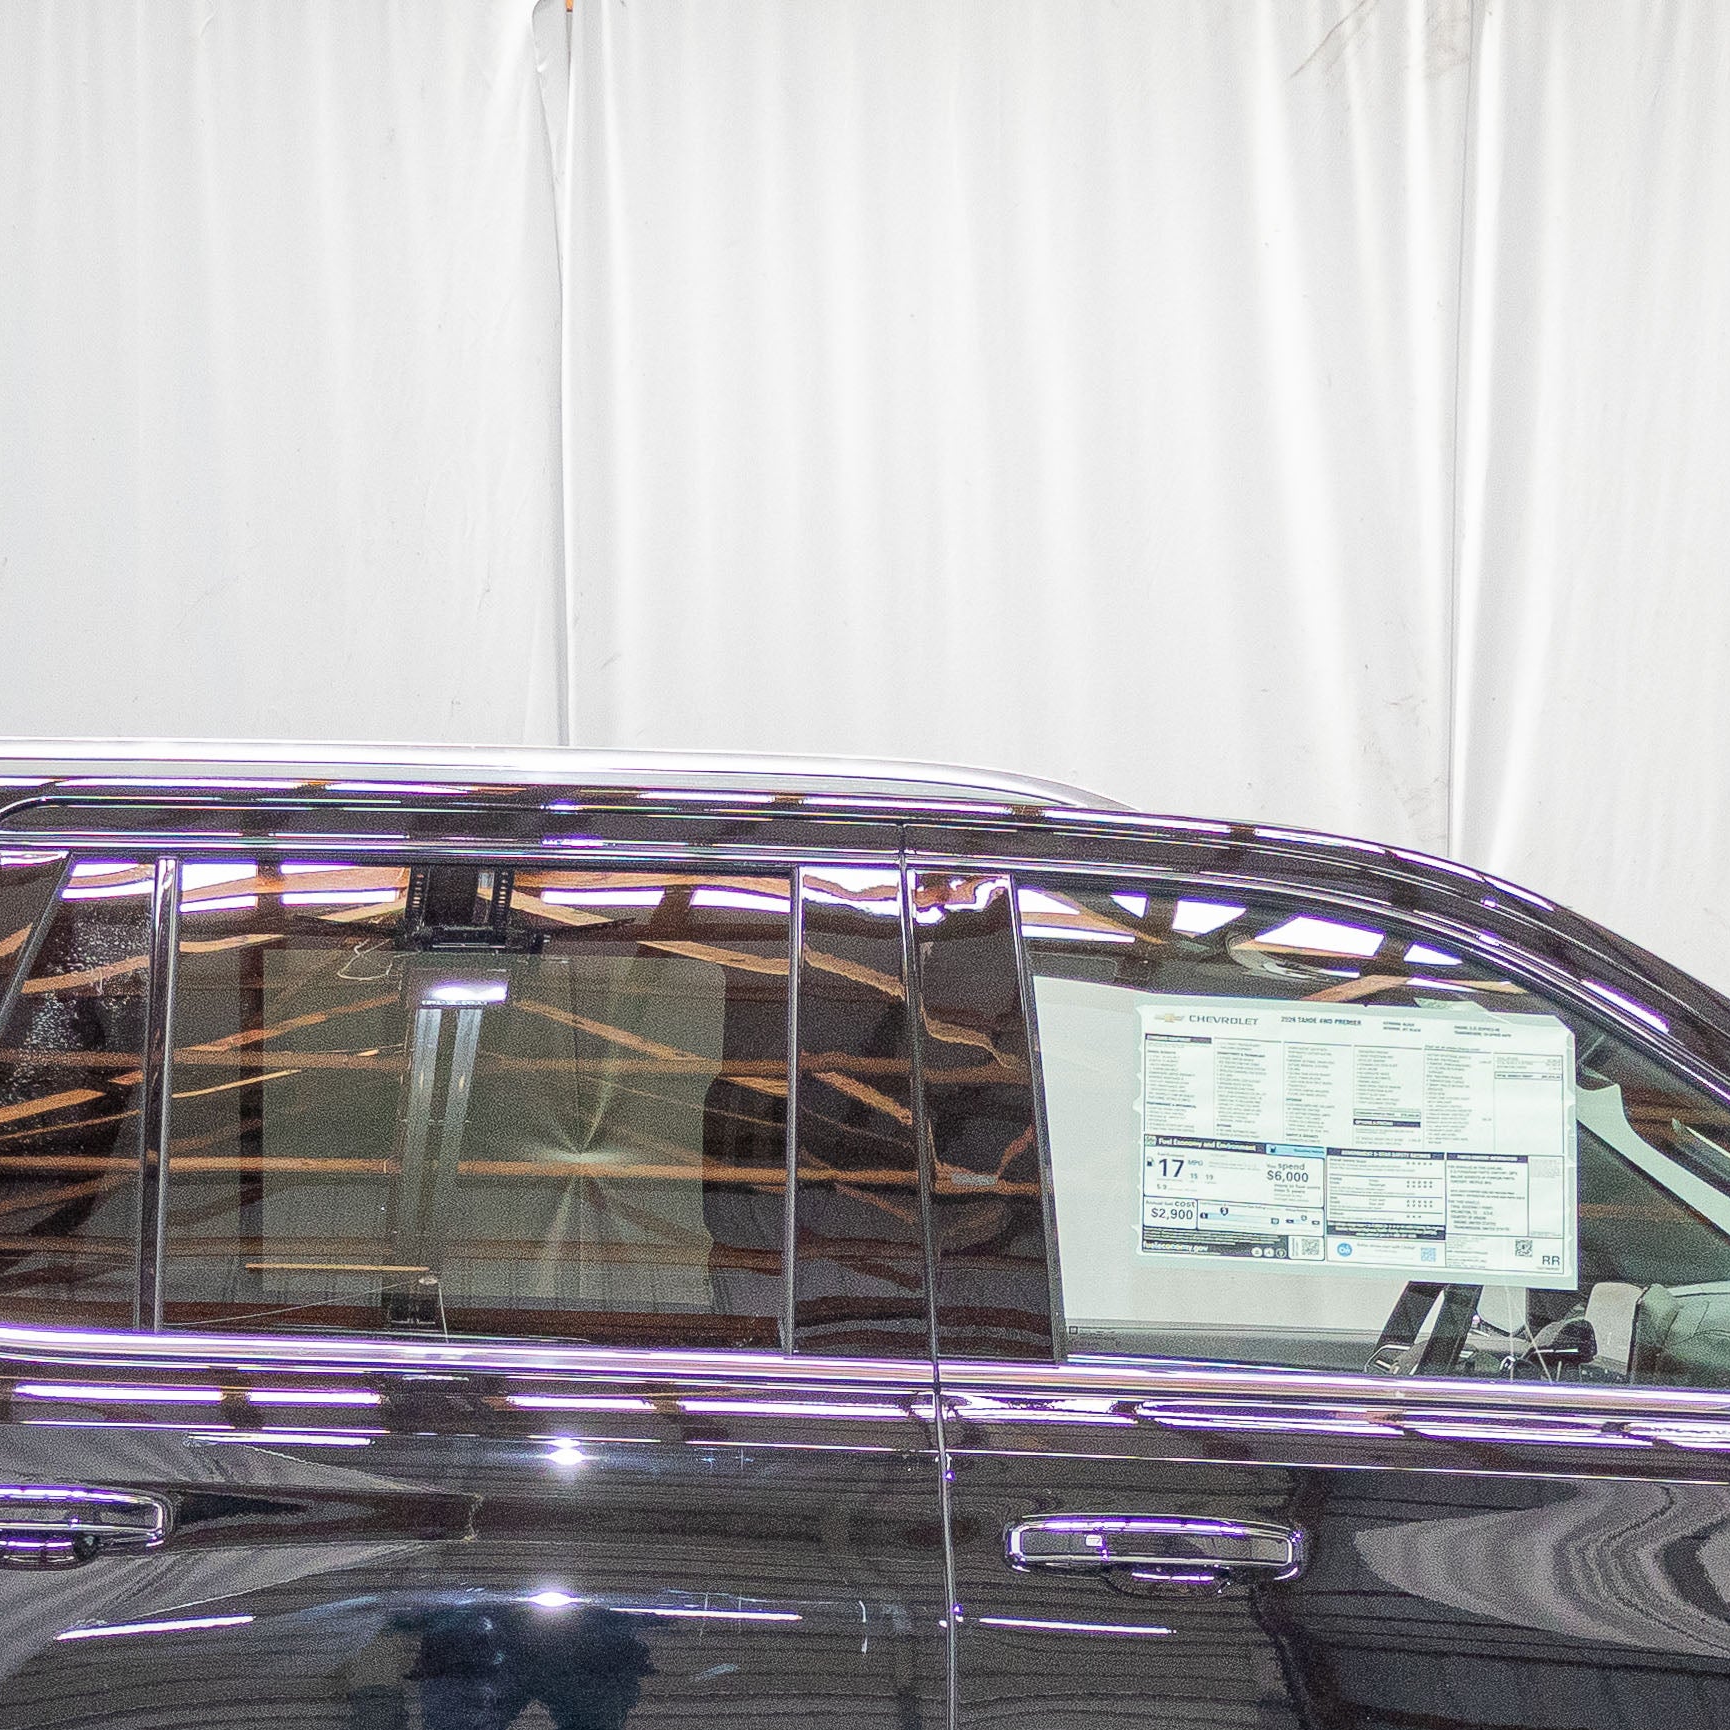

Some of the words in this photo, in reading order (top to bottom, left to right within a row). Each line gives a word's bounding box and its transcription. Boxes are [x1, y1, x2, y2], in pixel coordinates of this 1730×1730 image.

[1189, 1015, 1259, 1026] CHEVROLET
[1298, 1016, 1317, 1024] TAHOE
[1158, 1158, 1185, 1178] 17
[1278, 1163, 1305, 1171] spend
[1266, 1170, 1309, 1183] $6,000
[1151, 1207, 1193, 1220] $2,900
[1541, 1255, 1560, 1266] RR
